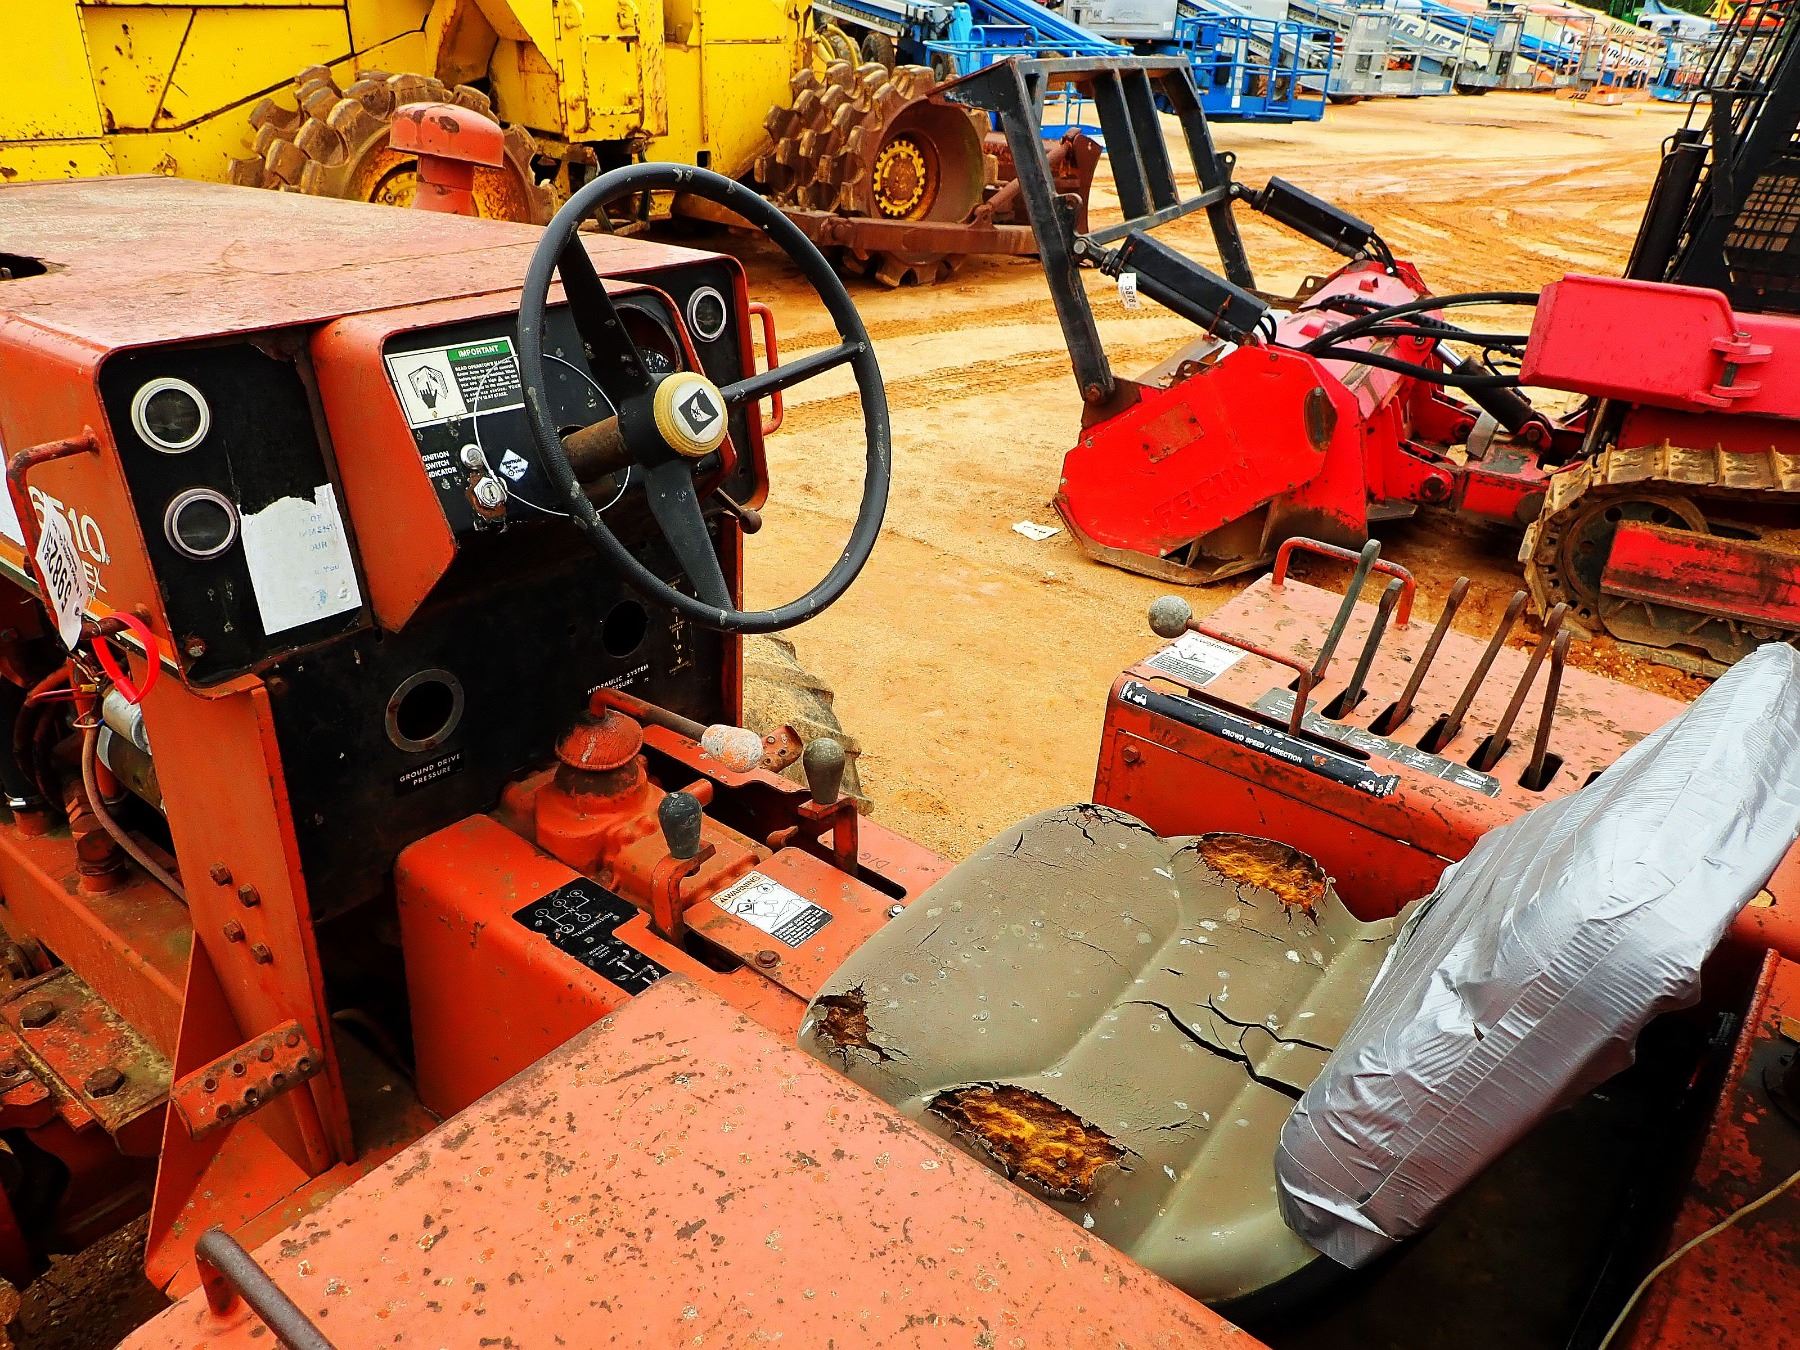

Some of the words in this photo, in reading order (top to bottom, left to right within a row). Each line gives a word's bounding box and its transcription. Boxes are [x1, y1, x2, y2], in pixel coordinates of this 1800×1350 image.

[458, 345, 498, 358] IMPORTANT
[421, 450, 449, 462] GNITION
[425, 459, 449, 470] SWITCH
[587, 675, 623, 695] HYDRAULIC
[626, 663, 649, 678] SYSTEM
[1222, 728, 1244, 744] CROWD
[1245, 736, 1266, 750] SPEED
[1270, 745, 1303, 763] DIRECTION
[399, 763, 435, 783] GROUND
[436, 753, 461, 771] DRIVE
[413, 764, 452, 786] PRESSURE
[724, 874, 762, 903] WARNING
